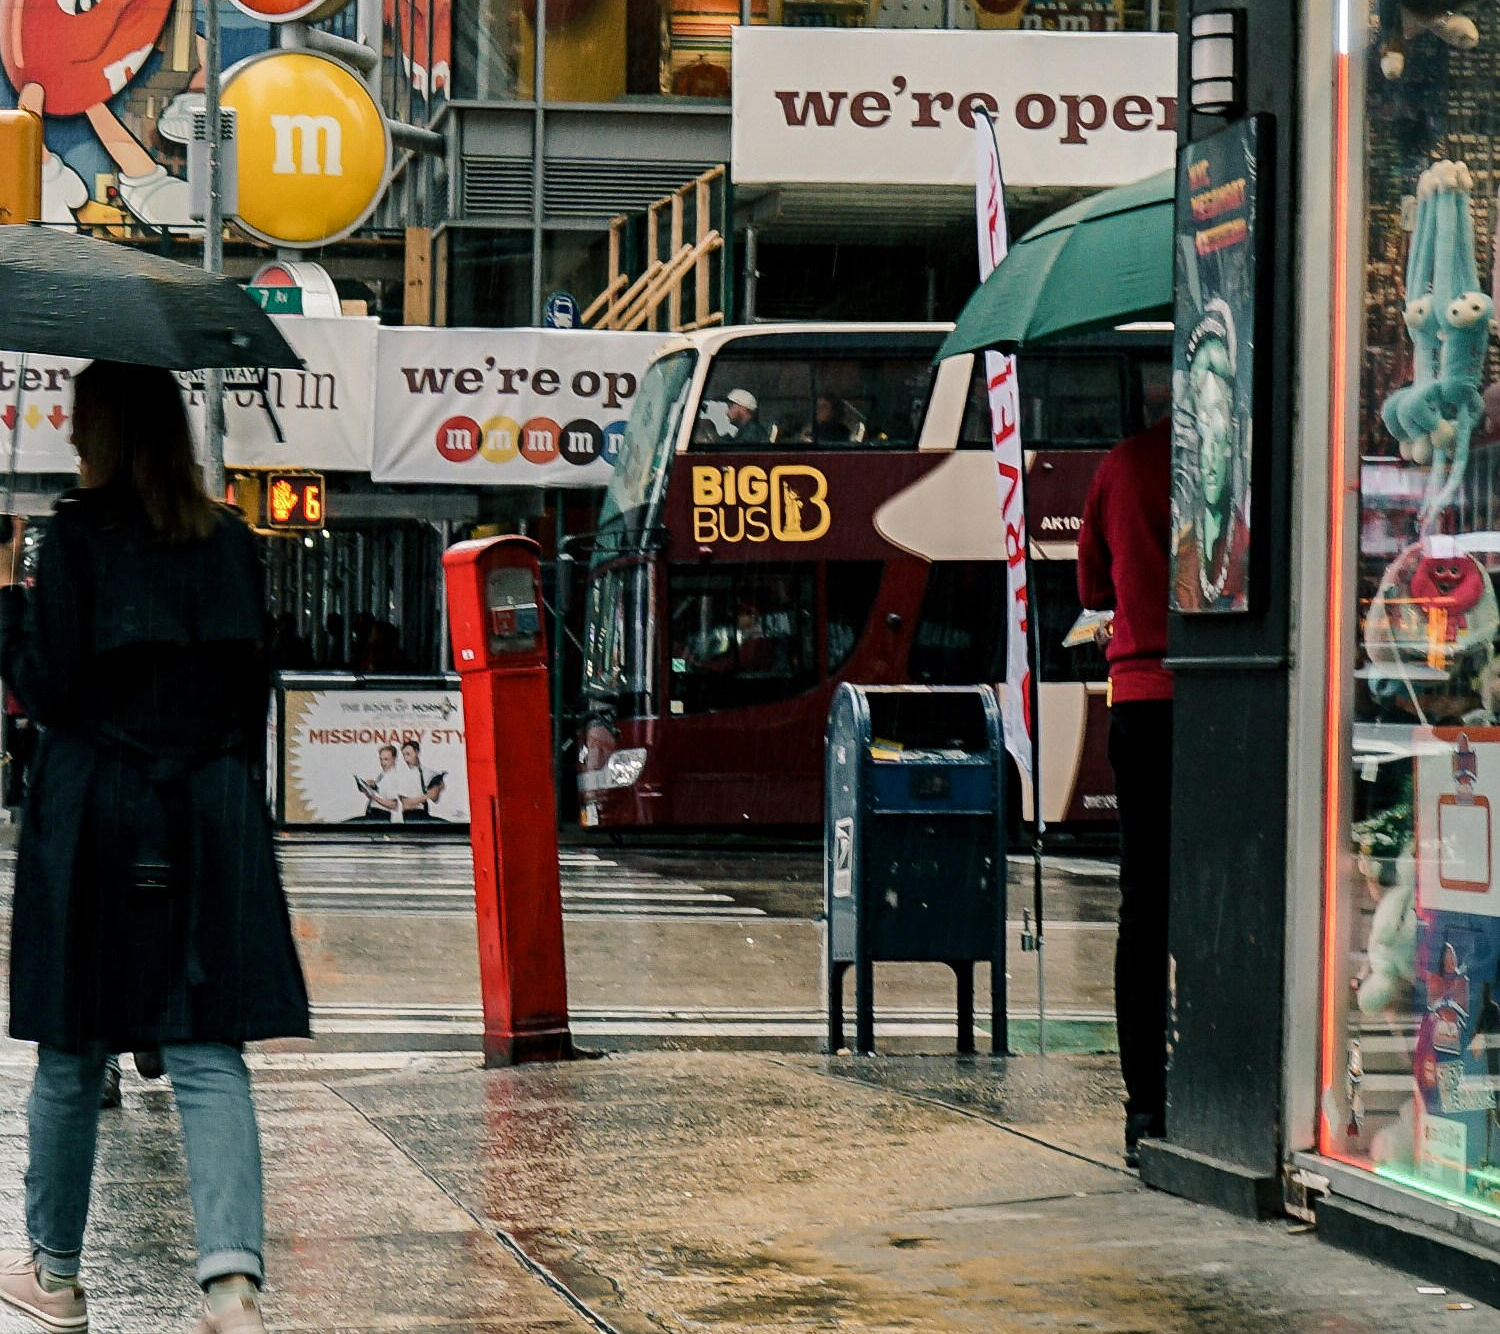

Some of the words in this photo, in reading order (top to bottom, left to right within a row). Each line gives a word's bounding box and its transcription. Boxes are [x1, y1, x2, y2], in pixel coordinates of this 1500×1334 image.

[775, 75, 999, 130] we're
[270, 113, 343, 176] m
[401, 356, 561, 396] we're
[304, 485, 322, 522] 6
[693, 465, 768, 506] BIG
[693, 507, 769, 543] BUS
[308, 728, 428, 746] MISSIONARY
